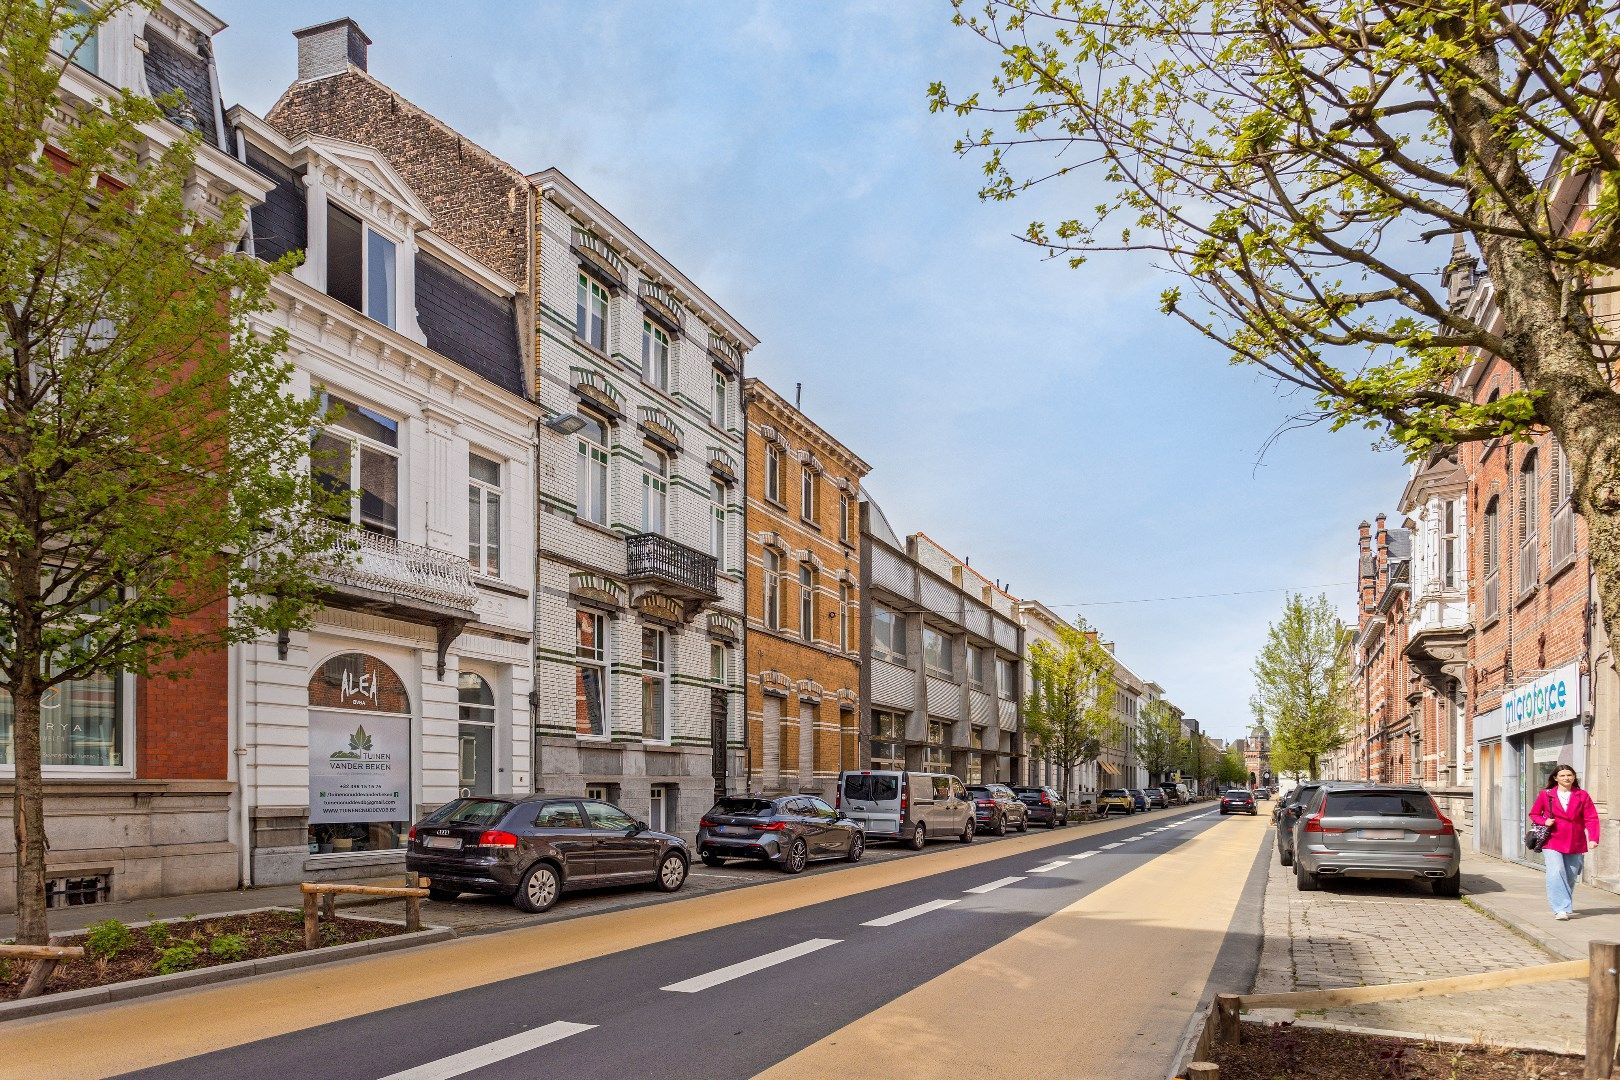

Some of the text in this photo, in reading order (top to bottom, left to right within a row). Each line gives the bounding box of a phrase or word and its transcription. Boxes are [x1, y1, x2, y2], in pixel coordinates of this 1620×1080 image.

[341, 668, 378, 706] ALEA
[1505, 680, 1566, 724] microforce
[329, 762, 391, 771] VANDER BEKEN
[362, 752, 391, 760] TUINEN
